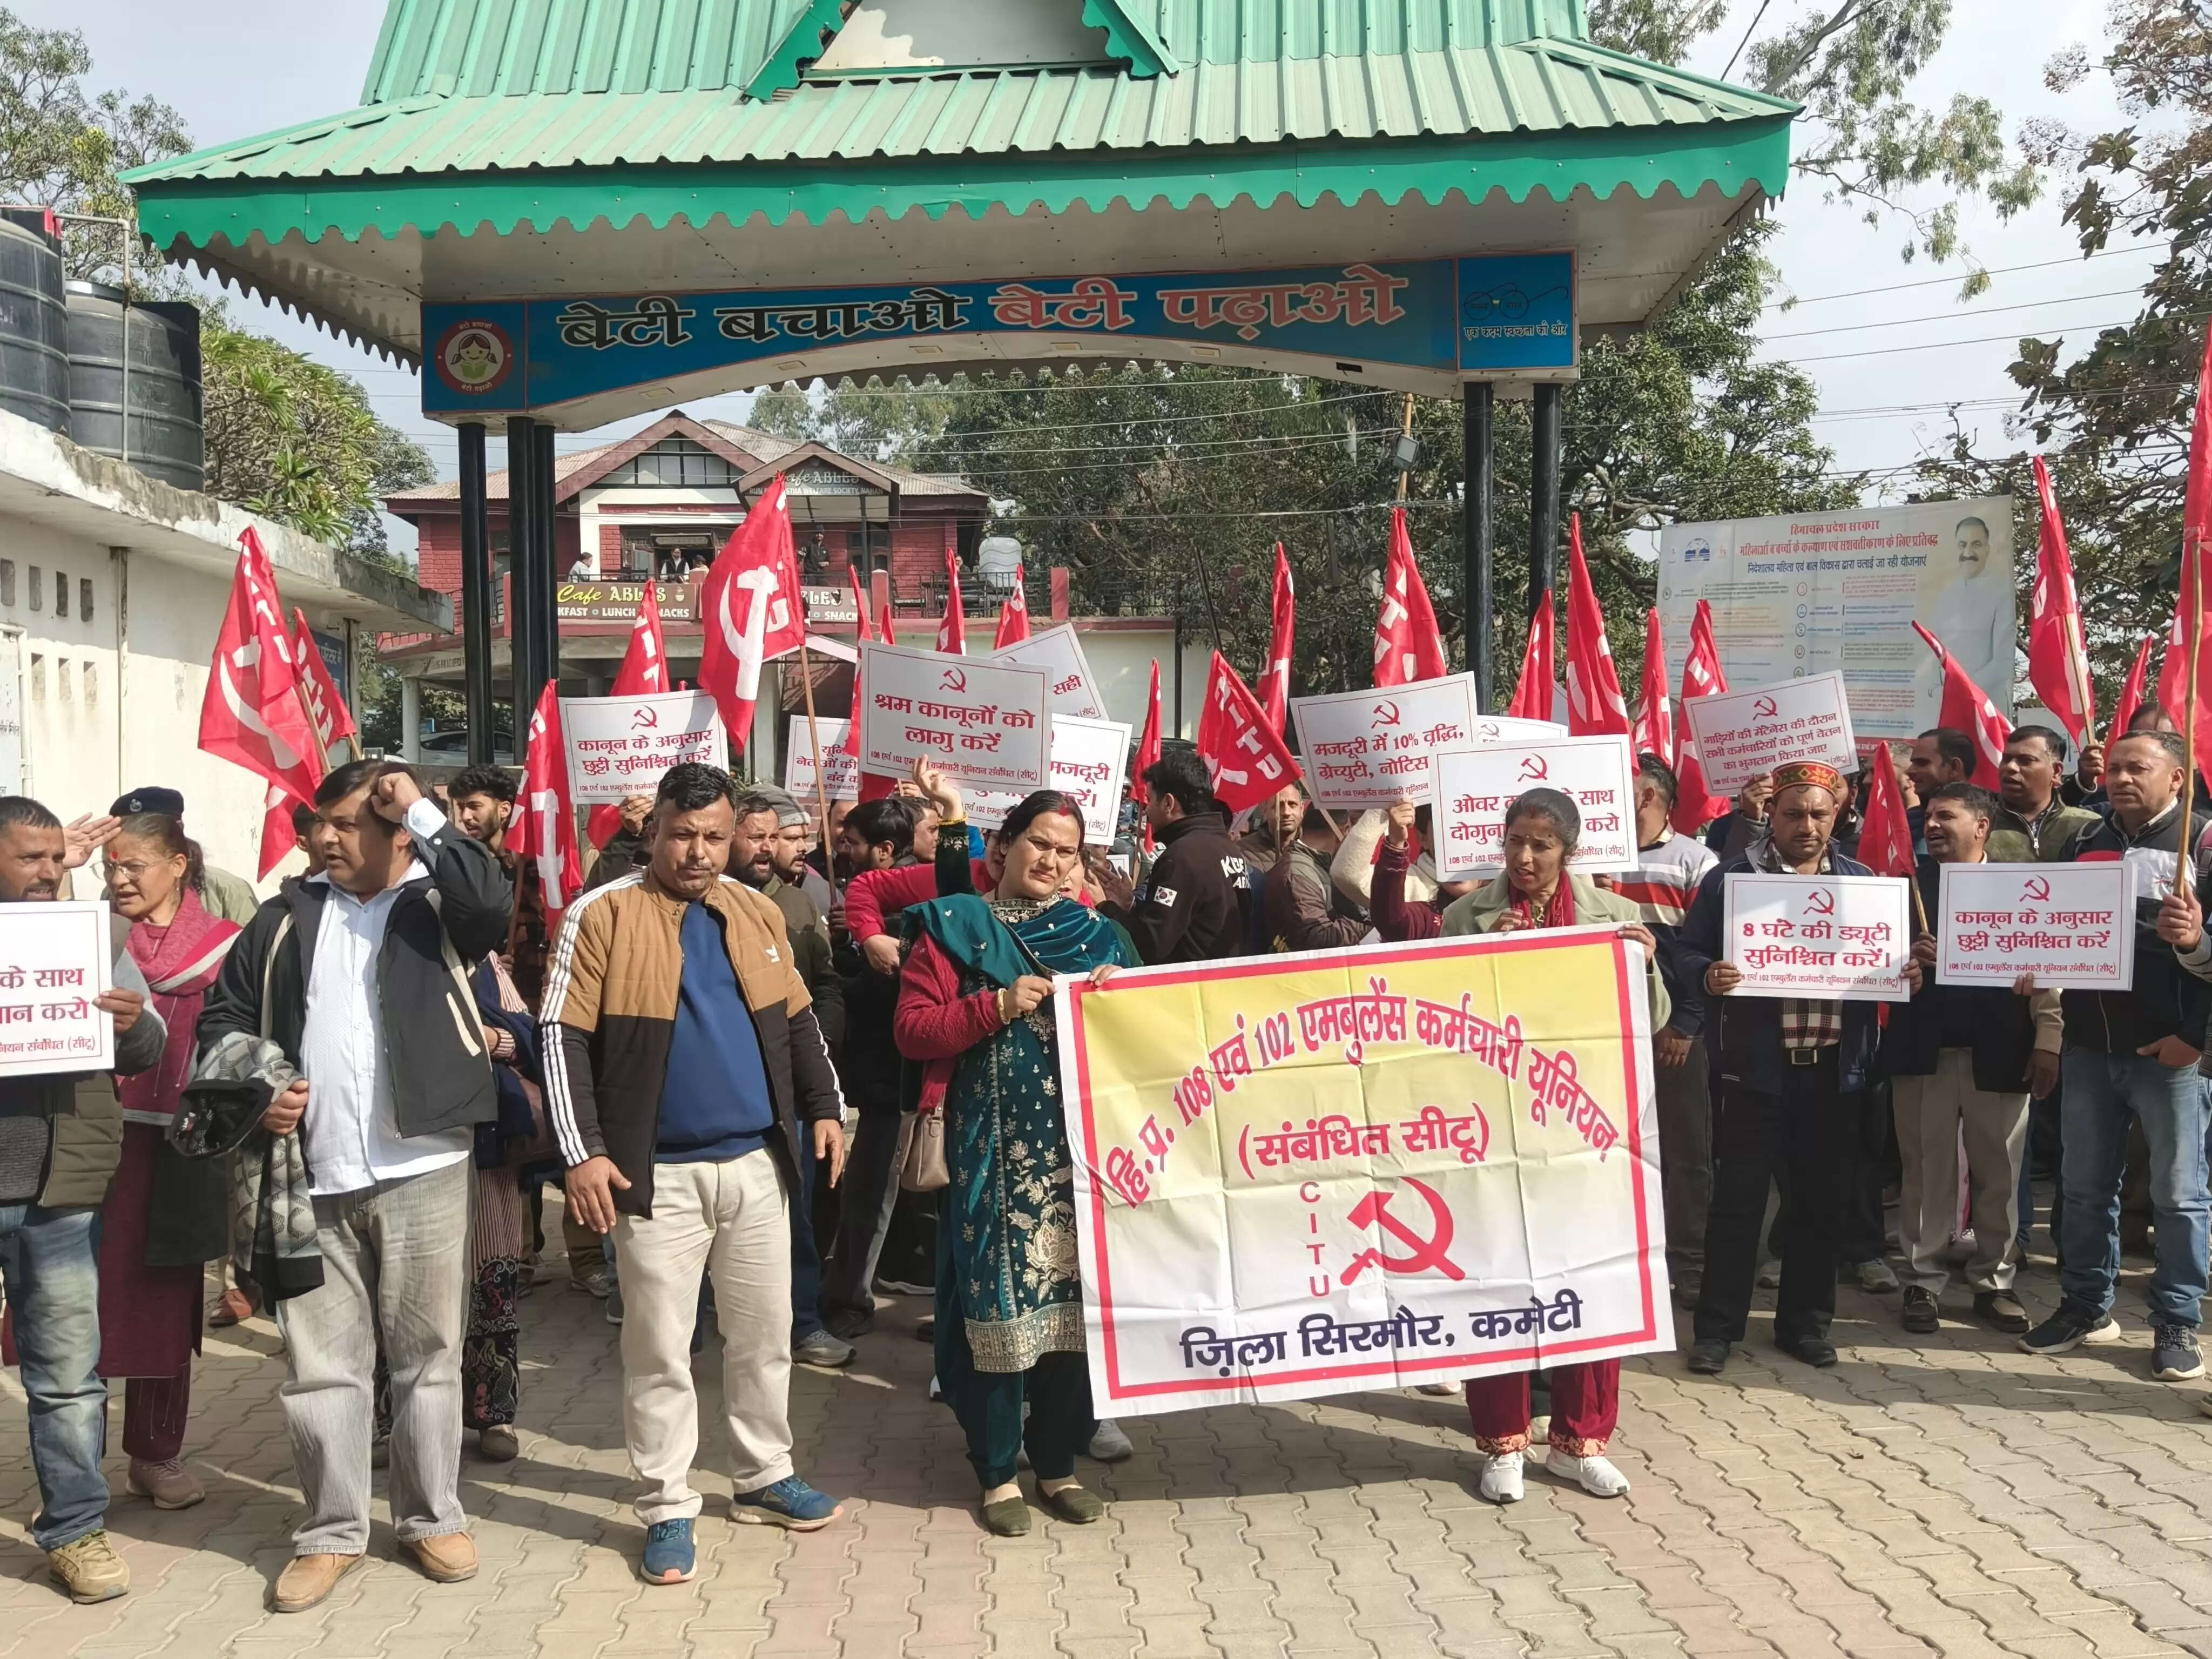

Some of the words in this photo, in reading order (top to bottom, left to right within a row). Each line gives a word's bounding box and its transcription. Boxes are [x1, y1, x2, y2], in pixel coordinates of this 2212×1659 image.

[557, 296, 696, 349] बेटी
[713, 287, 972, 343] बचाओ
[989, 277, 1137, 331] बेटी
[1157, 264, 1408, 341] पढ़ाओ
[1464, 326, 1479, 341] एक
[1481, 326, 1502, 339] कदम
[1503, 325, 1534, 337] स्वच्छता
[1536, 319, 1549, 336] की
[1552, 319, 1568, 335] ओर
[1849, 520, 1880, 531] सरकार
[1748, 562, 1775, 574] निदेशालय
[1776, 561, 1794, 572] महिला
[1796, 559, 1805, 572] एवं
[1806, 562, 1818, 571] बाल
[1819, 558, 1840, 570] विकास
[1842, 559, 1854, 570] द्वारा
[1857, 556, 1874, 569] चलाई
[1876, 558, 1885, 568] जा
[1887, 555, 1898, 567] रही
[557, 585, 603, 604] Cafe
[609, 586, 666, 602] ABLS
[602, 608, 636, 617] LUNCH
[1053, 675, 1082, 695] सही
[875, 694, 912, 714] श्रम
[918, 701, 998, 729] कानूनों
[1002, 709, 1035, 729] को
[1703, 730, 1735, 745] गाड़ियों
[1737, 726, 1752, 740] की
[1790, 718, 1805, 730] की
[1807, 712, 1837, 726] दौरान
[577, 739, 627, 755] कानून
[631, 735, 650, 750] के
[655, 730, 713, 749] अनुसार
[960, 732, 1002, 752] करें
[1313, 736, 1367, 759] मजदूरी
[1372, 733, 1388, 751] में
[1393, 732, 1419, 750] 10%
[1705, 747, 1725, 759] सभी
[1726, 737, 1777, 756] कर्मचारियों
[1780, 736, 1793, 747] को
[1797, 730, 1814, 745] पूर्ण
[1817, 725, 1842, 738] वेतन
[582, 757, 610, 775] छुट्टी
[614, 753, 680, 774] सुनिश्चित
[685, 745, 712, 763] करें
[871, 750, 880, 758] 108
[881, 751, 892, 761] एवं
[931, 761, 960, 772] कर्मचारी
[961, 765, 987, 776] यूनियन
[1017, 768, 1037, 781] (सीटू)
[1378, 756, 1429, 775] नोटिस
[1723, 761, 1737, 770] का
[1739, 754, 1776, 771] भुगतान
[1778, 749, 1805, 761] किया
[1808, 743, 1827, 756] जाए
[1453, 794, 1499, 813] ओवर
[1579, 790, 1615, 805] साथ
[1584, 813, 1620, 832] करो
[1461, 853, 1473, 863] एवं
[1606, 845, 1626, 857] (सीटू)
[1955, 911, 2013, 929] कानून
[2018, 908, 2039, 925] के
[2045, 911, 2114, 929] अनुसार
[1743, 923, 1754, 937] 8
[1761, 918, 1796, 938] घंटे
[1800, 920, 1833, 939] की
[1838, 922, 1892, 947] ड्यूटी
[1957, 930, 1990, 951] छुट्टी
[1995, 931, 2072, 953] सुनिश्चित
[2076, 930, 2111, 948] करें
[1744, 945, 1837, 969] सुनिश्चित
[1961, 961, 1972, 970] एवं
[2014, 962, 2041, 972] कर्मचारी
[2043, 962, 2068, 974] यूनियन
[2096, 962, 2116, 974] (सीटू)
[34, 967, 84, 987] साथ
[1879, 976, 1899, 988] (सीटू)
[41, 996, 90, 1021] करो
[68, 1035, 96, 1051] (सीटू)
[1172, 1070, 1212, 1126] 108
[1209, 1013, 1253, 1094] एवं
[1254, 1011, 1296, 1068] 102
[1297, 975, 1407, 1066] एमबुलेंस
[1416, 993, 1522, 1081] कर्मचारी
[1528, 1043, 1621, 1163] यूनियन
[1238, 1114, 1390, 1181] (संबंधित
[1399, 1102, 1490, 1163] सीटू)
[1299, 1181, 1331, 1298] CITU
[1179, 1325, 1286, 1382] ज़िला
[1297, 1305, 1455, 1358] सिरमौर,
[1469, 1288, 1583, 1343] कमेटी
